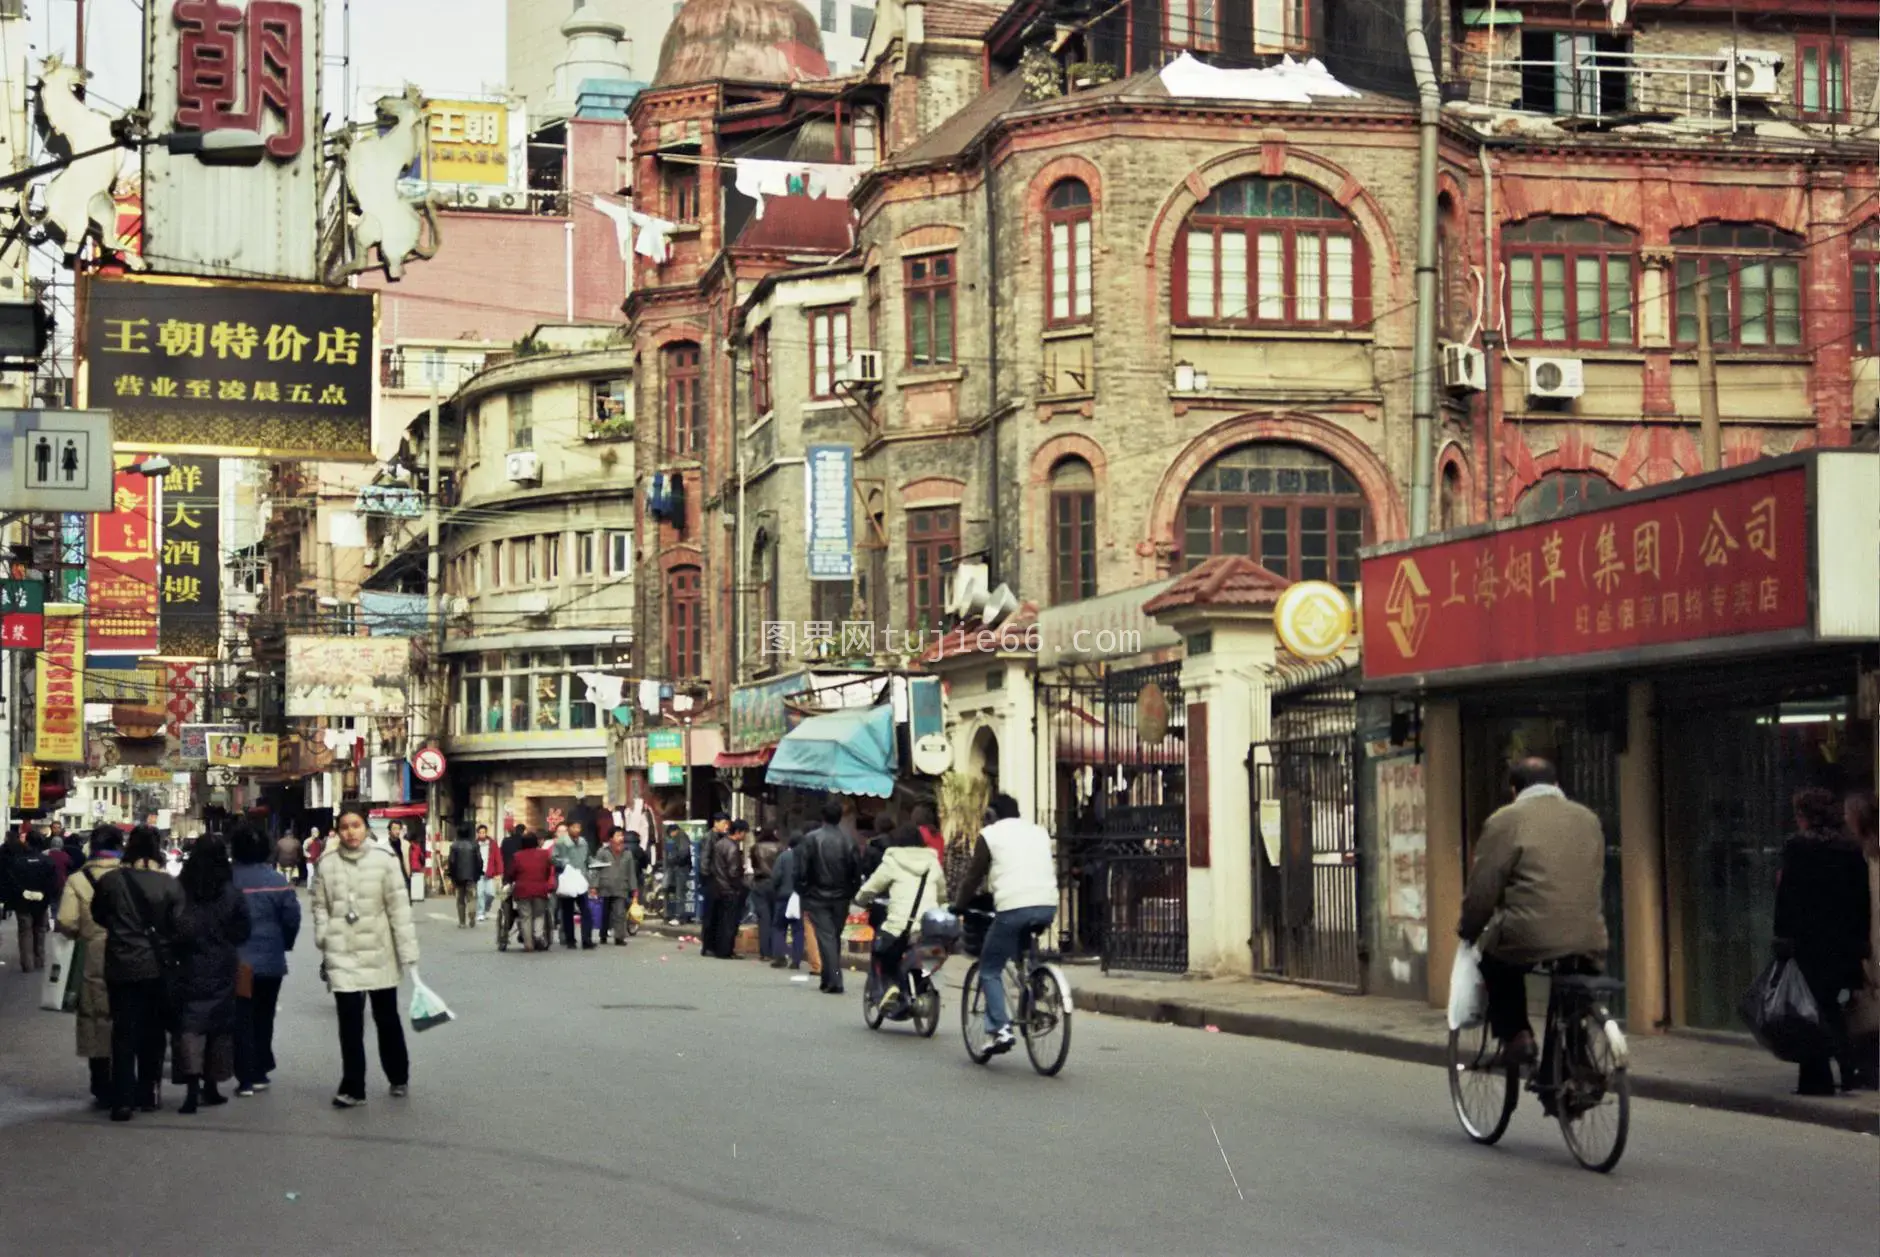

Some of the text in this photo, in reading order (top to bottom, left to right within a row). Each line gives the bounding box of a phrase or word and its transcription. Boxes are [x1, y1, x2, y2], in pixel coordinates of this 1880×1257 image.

[173, 0, 303, 157] 朝
[102, 318, 361, 365] 王朝特价店
[113, 374, 347, 405] 营业至凌晨五点
